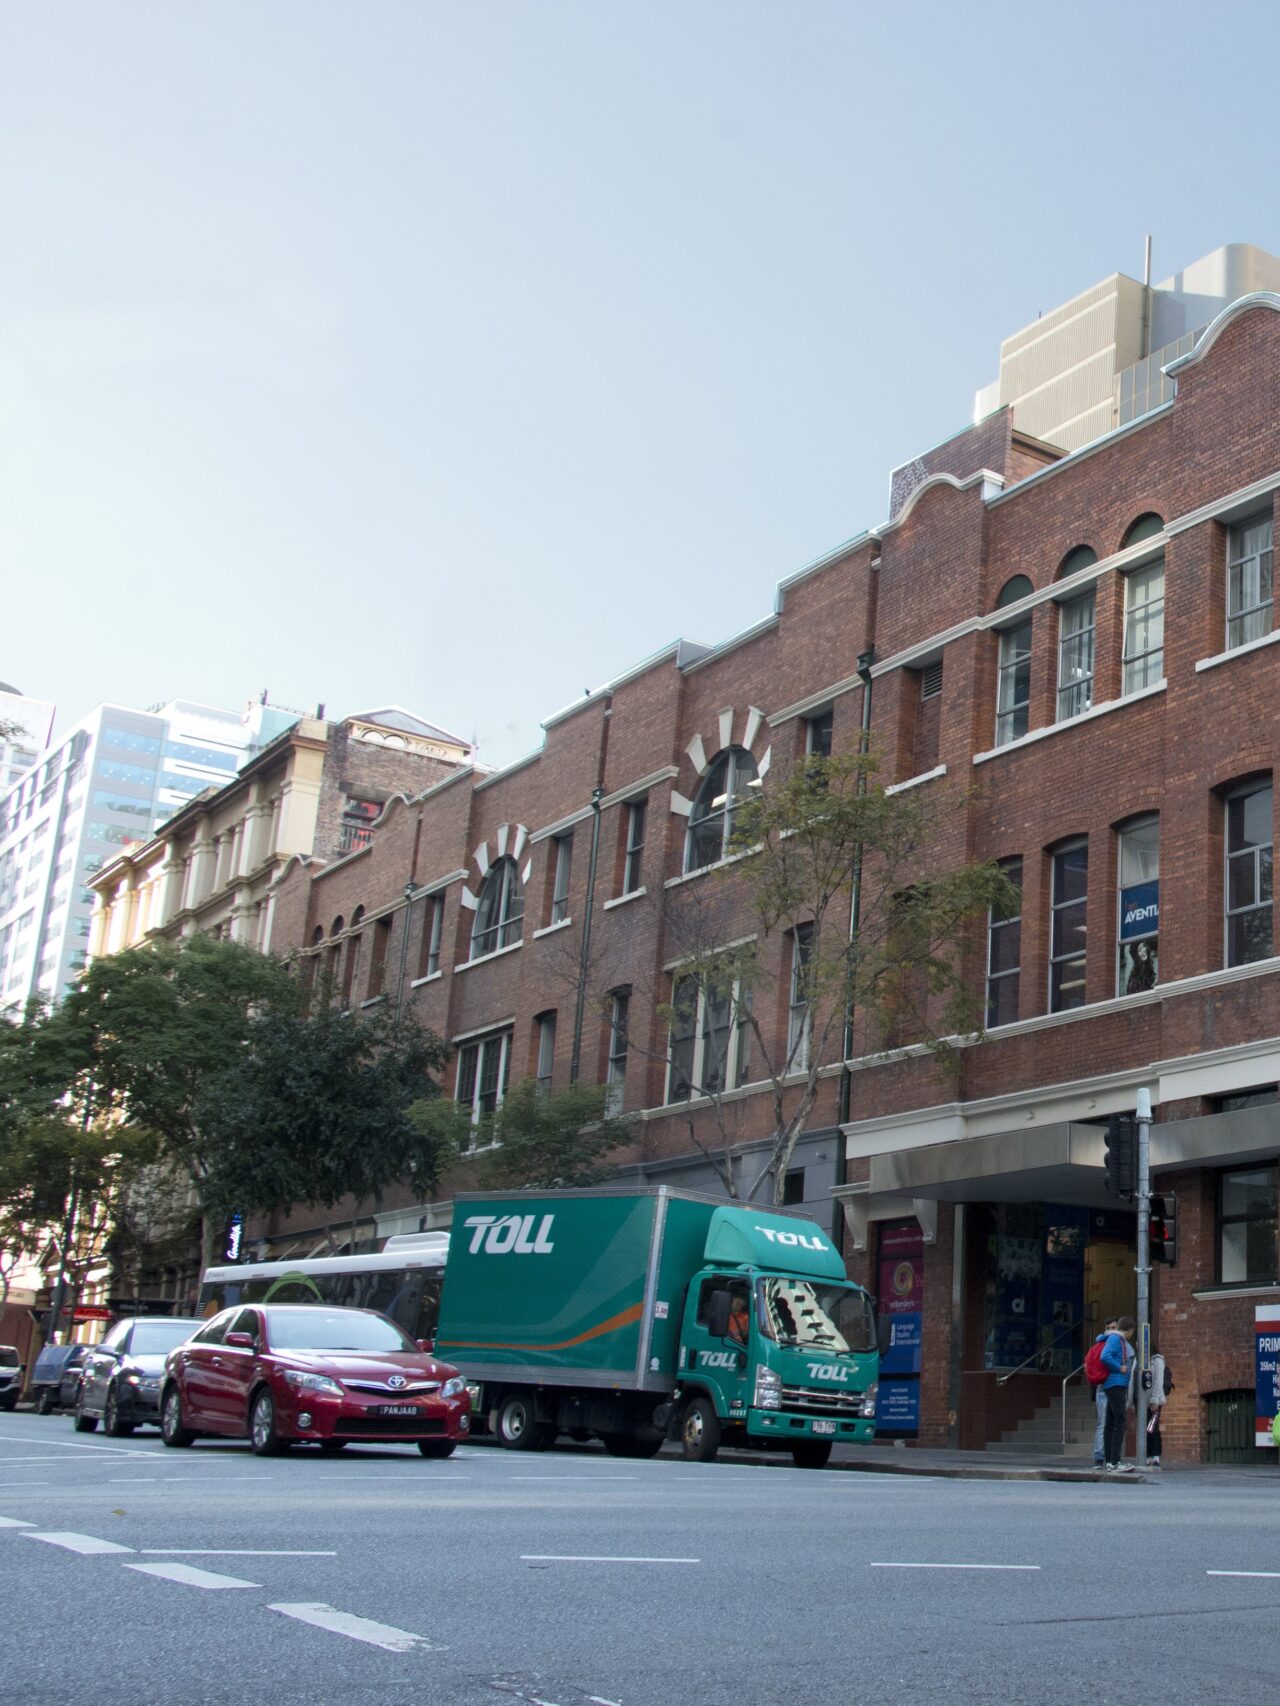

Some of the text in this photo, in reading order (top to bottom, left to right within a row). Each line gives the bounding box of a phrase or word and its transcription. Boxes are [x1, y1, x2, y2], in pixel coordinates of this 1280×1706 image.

[463, 1214, 555, 1254] TOLL
[754, 1225, 828, 1251] TOLL
[700, 1350, 737, 1368] TOLL
[806, 1362, 849, 1382] TOLL
[383, 1406, 417, 1415] PANJAAB
